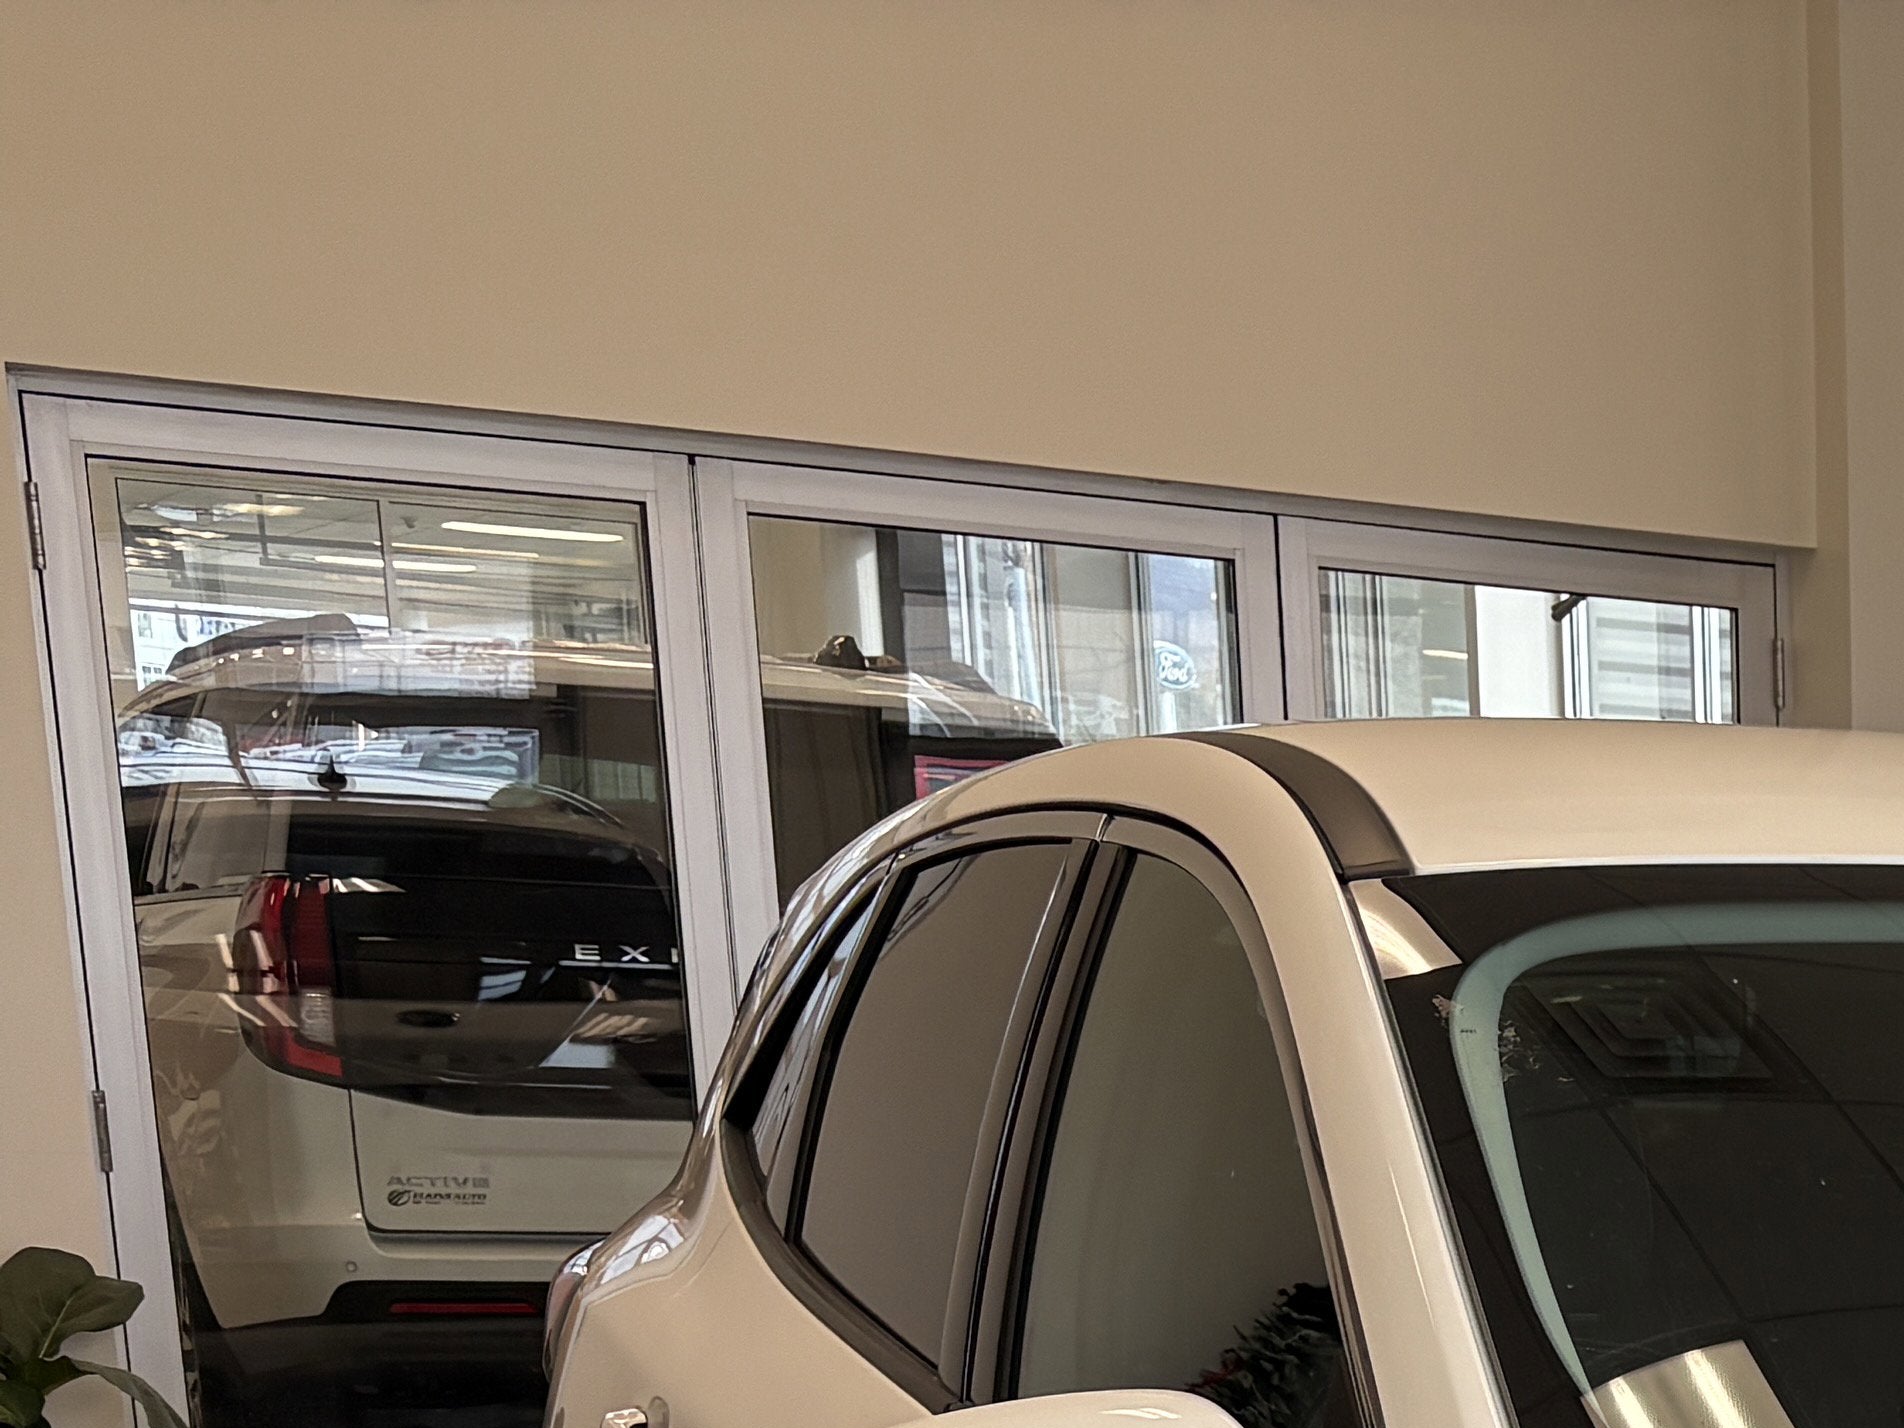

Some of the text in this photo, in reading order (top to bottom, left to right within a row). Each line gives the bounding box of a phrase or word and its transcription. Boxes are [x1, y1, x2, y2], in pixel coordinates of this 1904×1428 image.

[1159, 651, 1190, 682] Ford
[574, 944, 679, 963] EX
[387, 1175, 490, 1189] ACTIVE
